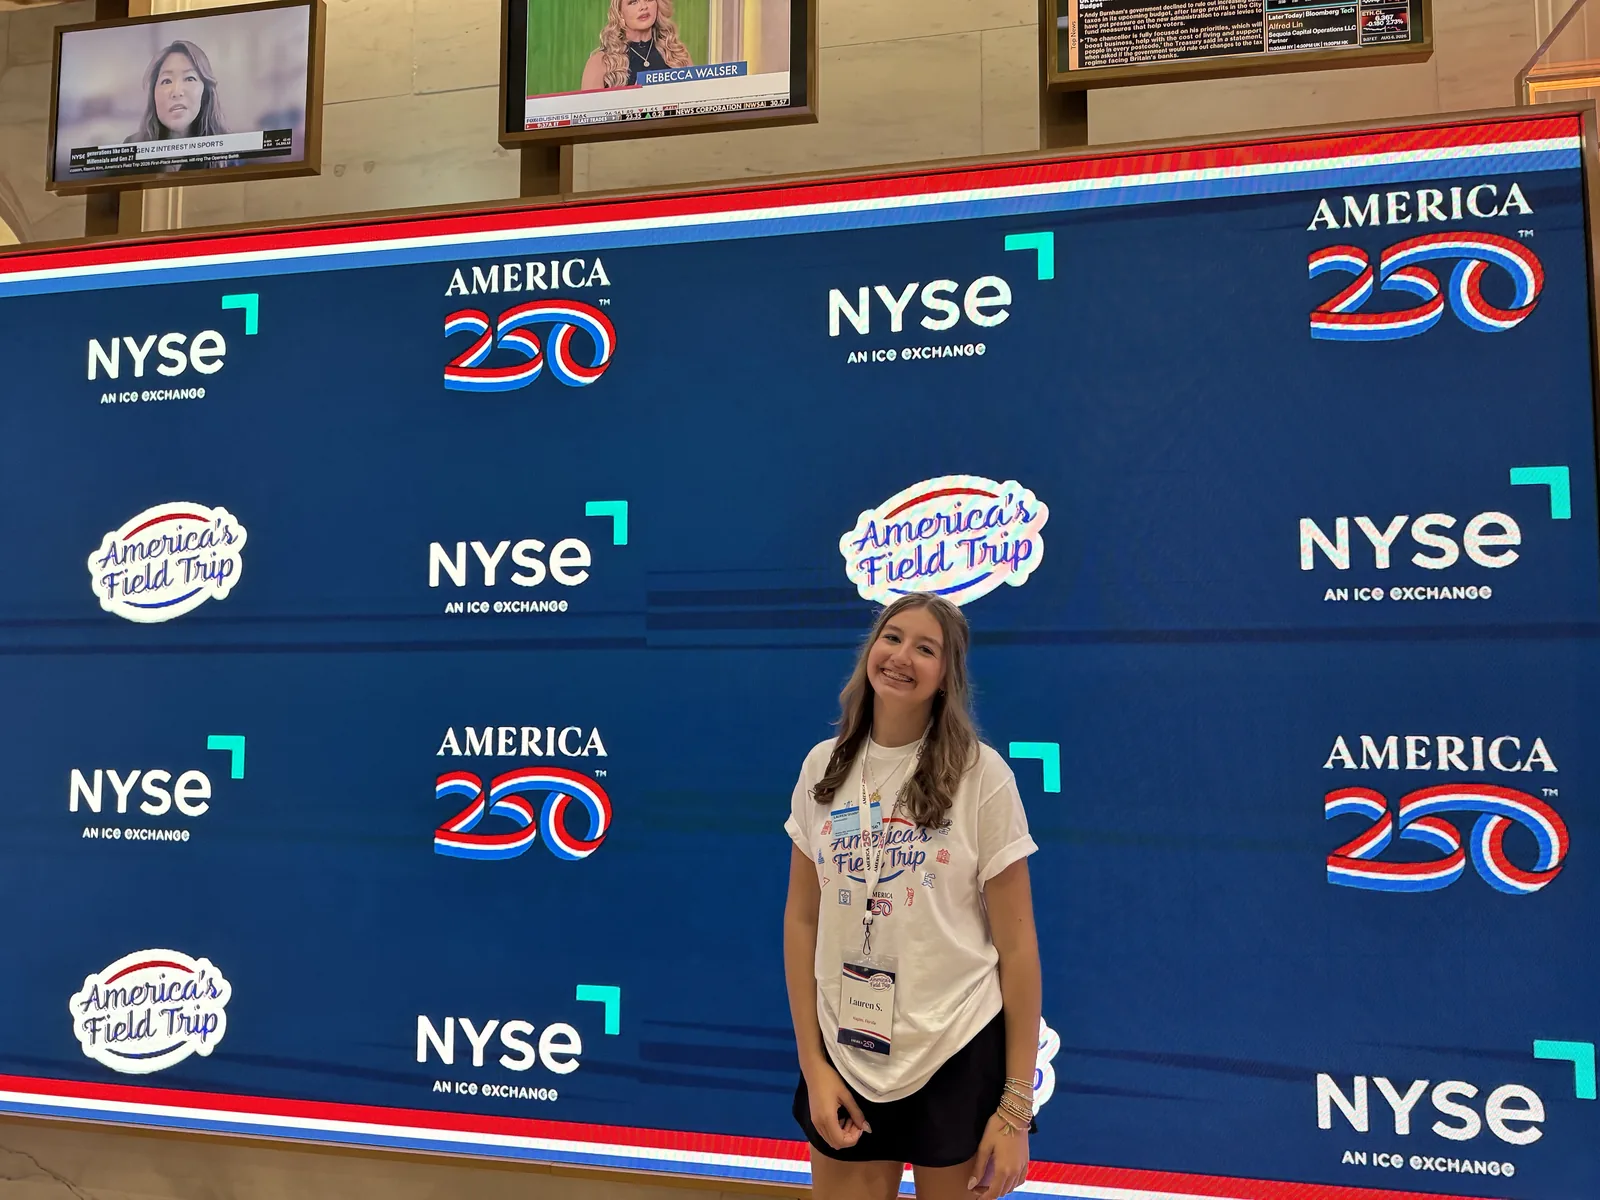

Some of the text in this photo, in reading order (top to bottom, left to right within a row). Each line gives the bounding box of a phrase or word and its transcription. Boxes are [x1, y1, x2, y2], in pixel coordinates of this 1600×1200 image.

[1312, 26, 1343, 34] Operations
[646, 66, 738, 84] REBECCA WALSER
[696, 103, 741, 113] CORPORATION
[156, 144, 188, 152] INTEREST
[1307, 183, 1533, 231] AMERICA
[445, 258, 610, 296] AMERICA
[1307, 231, 1545, 341] 250
[444, 299, 617, 392] 250
[848, 351, 868, 363] AN
[101, 393, 117, 404] AN
[850, 493, 1037, 554] America's
[97, 518, 238, 570] America's
[857, 531, 1032, 586] Field Trip
[100, 552, 234, 598] Field Trip
[445, 602, 464, 614] AN
[1324, 588, 1349, 601] AN
[437, 727, 608, 757] AMERICA
[1323, 736, 1559, 773] AMERICA
[434, 766, 613, 860] 250
[83, 828, 99, 839] AN
[1324, 783, 1570, 895] 250
[886, 845, 926, 872] Trip
[872, 891, 894, 899] MERICA
[78, 970, 223, 1014] America's
[849, 997, 883, 1012] Lauren S.
[82, 1004, 218, 1046] Field Trip
[433, 1081, 452, 1094] AN
[1342, 1151, 1367, 1166] AN
